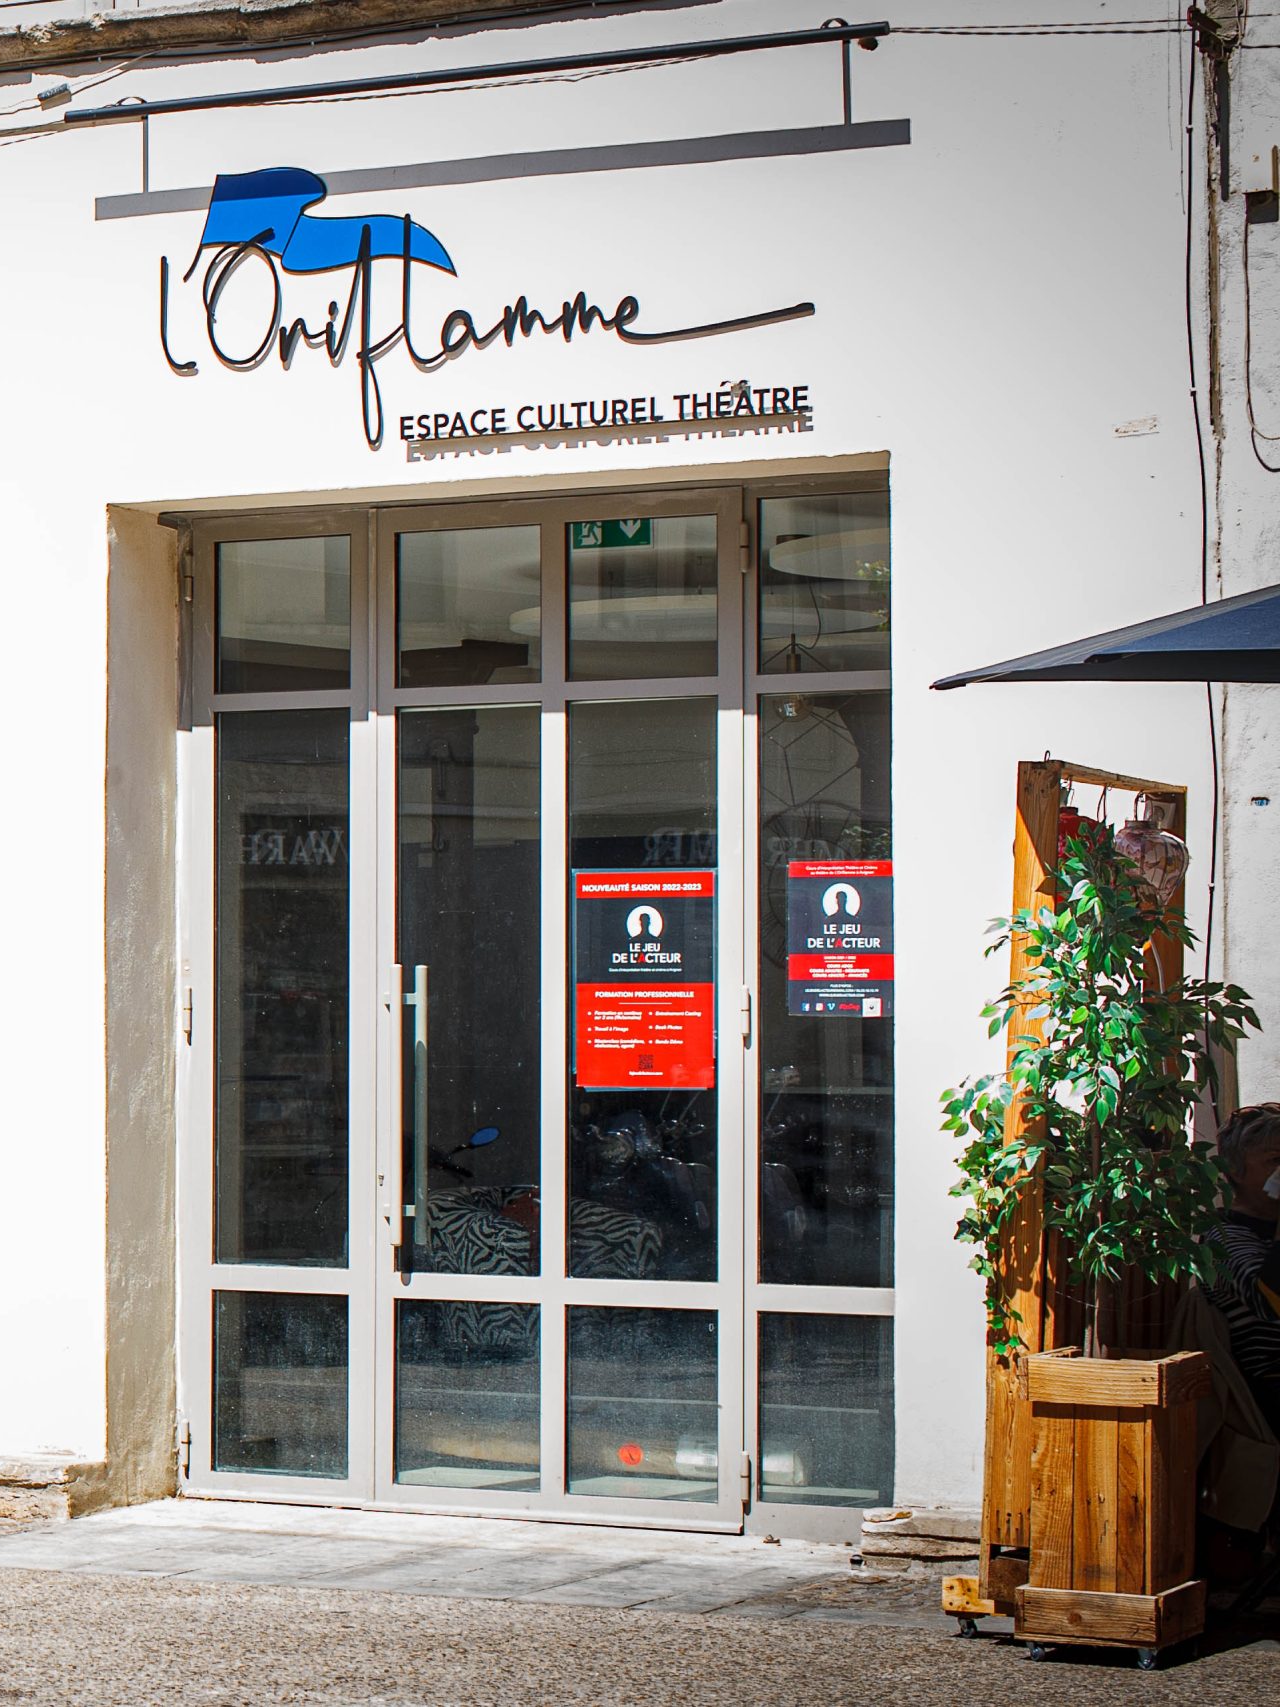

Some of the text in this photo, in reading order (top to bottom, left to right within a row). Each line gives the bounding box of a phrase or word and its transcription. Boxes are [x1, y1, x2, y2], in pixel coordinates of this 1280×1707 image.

[400, 380, 809, 440] ESPACE CULTUREL THÉÂTRE
[582, 883, 702, 892] NOUVEAUTÉ SAISON 2022-2023
[823, 923, 861, 935] LE JEU
[807, 937, 880, 948] DE L'ACTEUR
[629, 943, 660, 953] LE JEU
[612, 953, 681, 963] DE L'ACTEUR
[634, 990, 695, 998] PROFESSIONNELLE
